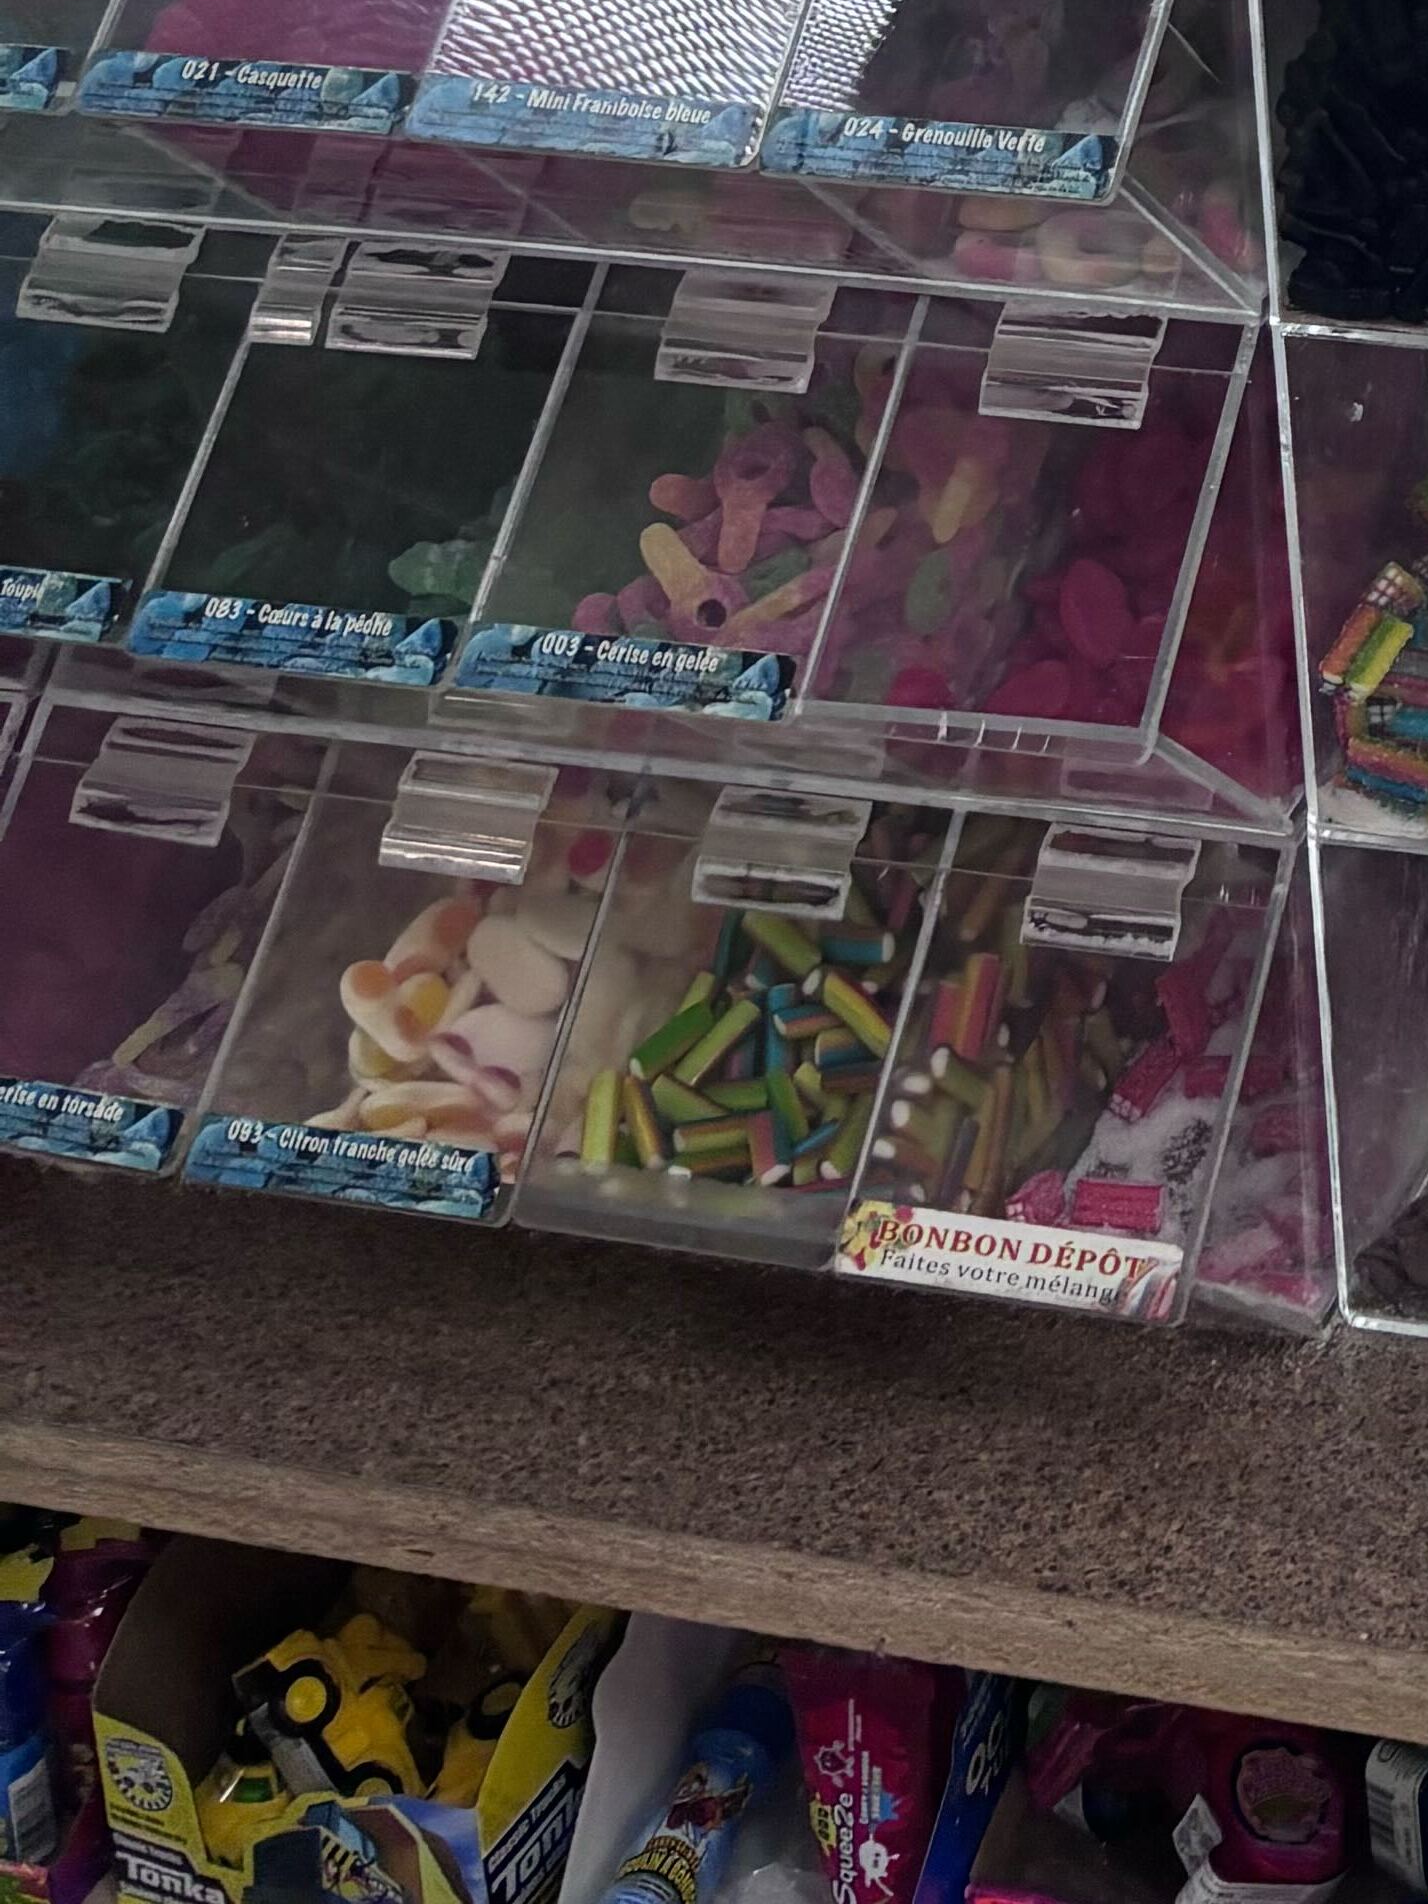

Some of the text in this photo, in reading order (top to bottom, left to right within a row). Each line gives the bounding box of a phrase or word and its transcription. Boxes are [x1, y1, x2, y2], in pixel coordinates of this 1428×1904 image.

[180, 59, 324, 91] 021 Casquette
[472, 82, 712, 126] 142 Mini Framboise bleue
[843, 116, 884, 139] 024
[996, 129, 1046, 153] Verte
[541, 632, 721, 675] 003 Cerise en gelée
[37, 1090, 124, 1123] en torsade
[278, 1126, 329, 1154] Citron
[332, 1133, 395, 1163] tranche
[397, 1144, 438, 1170] gelée
[878, 1218, 1151, 1280] BONBON DÉPÔT
[880, 1247, 1021, 1288] Faites votre
